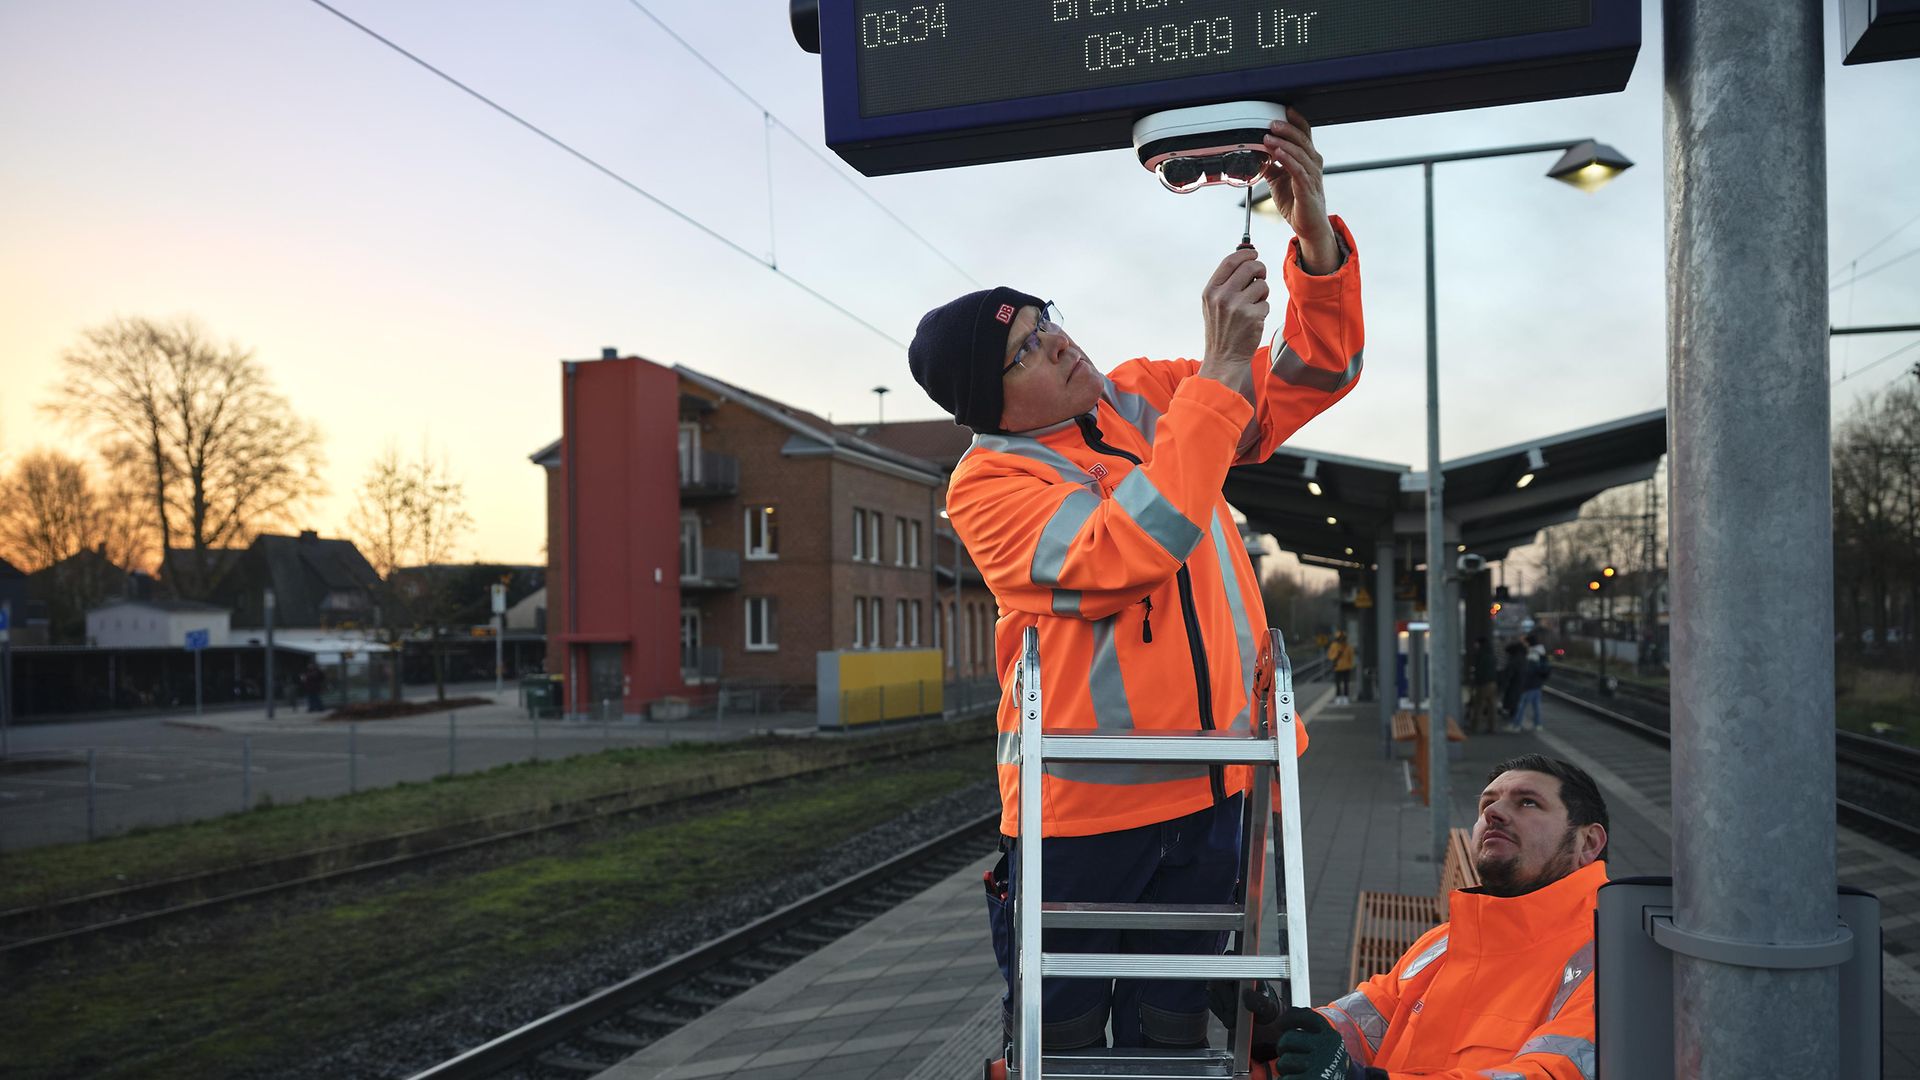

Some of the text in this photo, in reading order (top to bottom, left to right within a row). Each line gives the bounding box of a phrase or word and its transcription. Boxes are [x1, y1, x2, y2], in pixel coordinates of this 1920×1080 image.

[862, 2, 949, 48] 09:34
[1053, 0, 1184, 22] Bre
[1084, 8, 1318, 71] 08:49:09 Uhr
[998, 305, 1013, 322] DB
